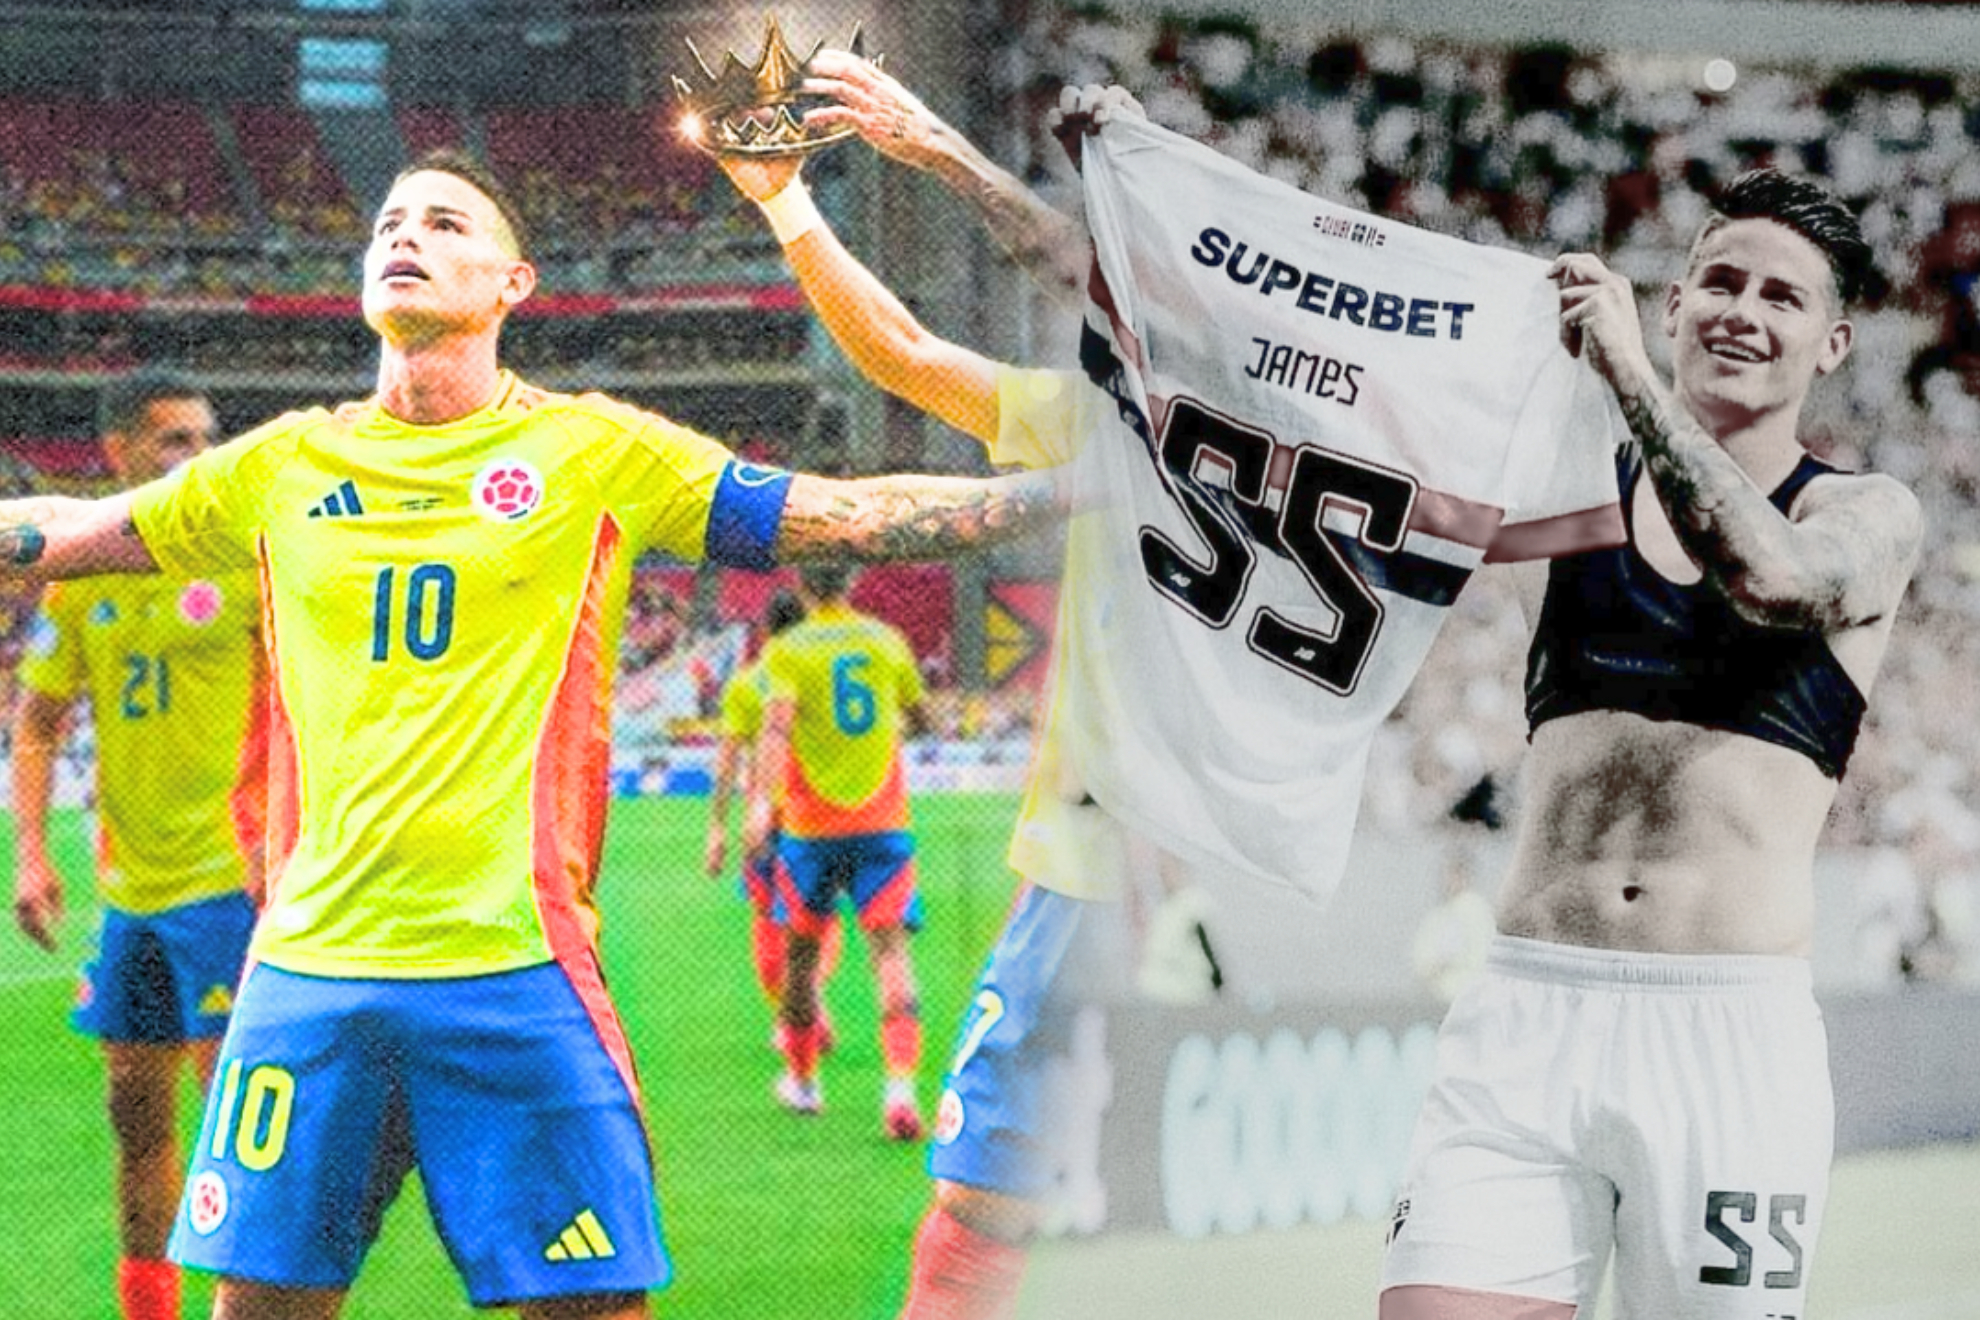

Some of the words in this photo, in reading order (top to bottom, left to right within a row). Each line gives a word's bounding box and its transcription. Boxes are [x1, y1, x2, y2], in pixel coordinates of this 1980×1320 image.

[1191, 227, 1474, 340] SUPERBET
[371, 563, 455, 662] 10
[120, 653, 169, 719] 21
[831, 651, 876, 738] 6
[211, 1058, 294, 1171] 10
